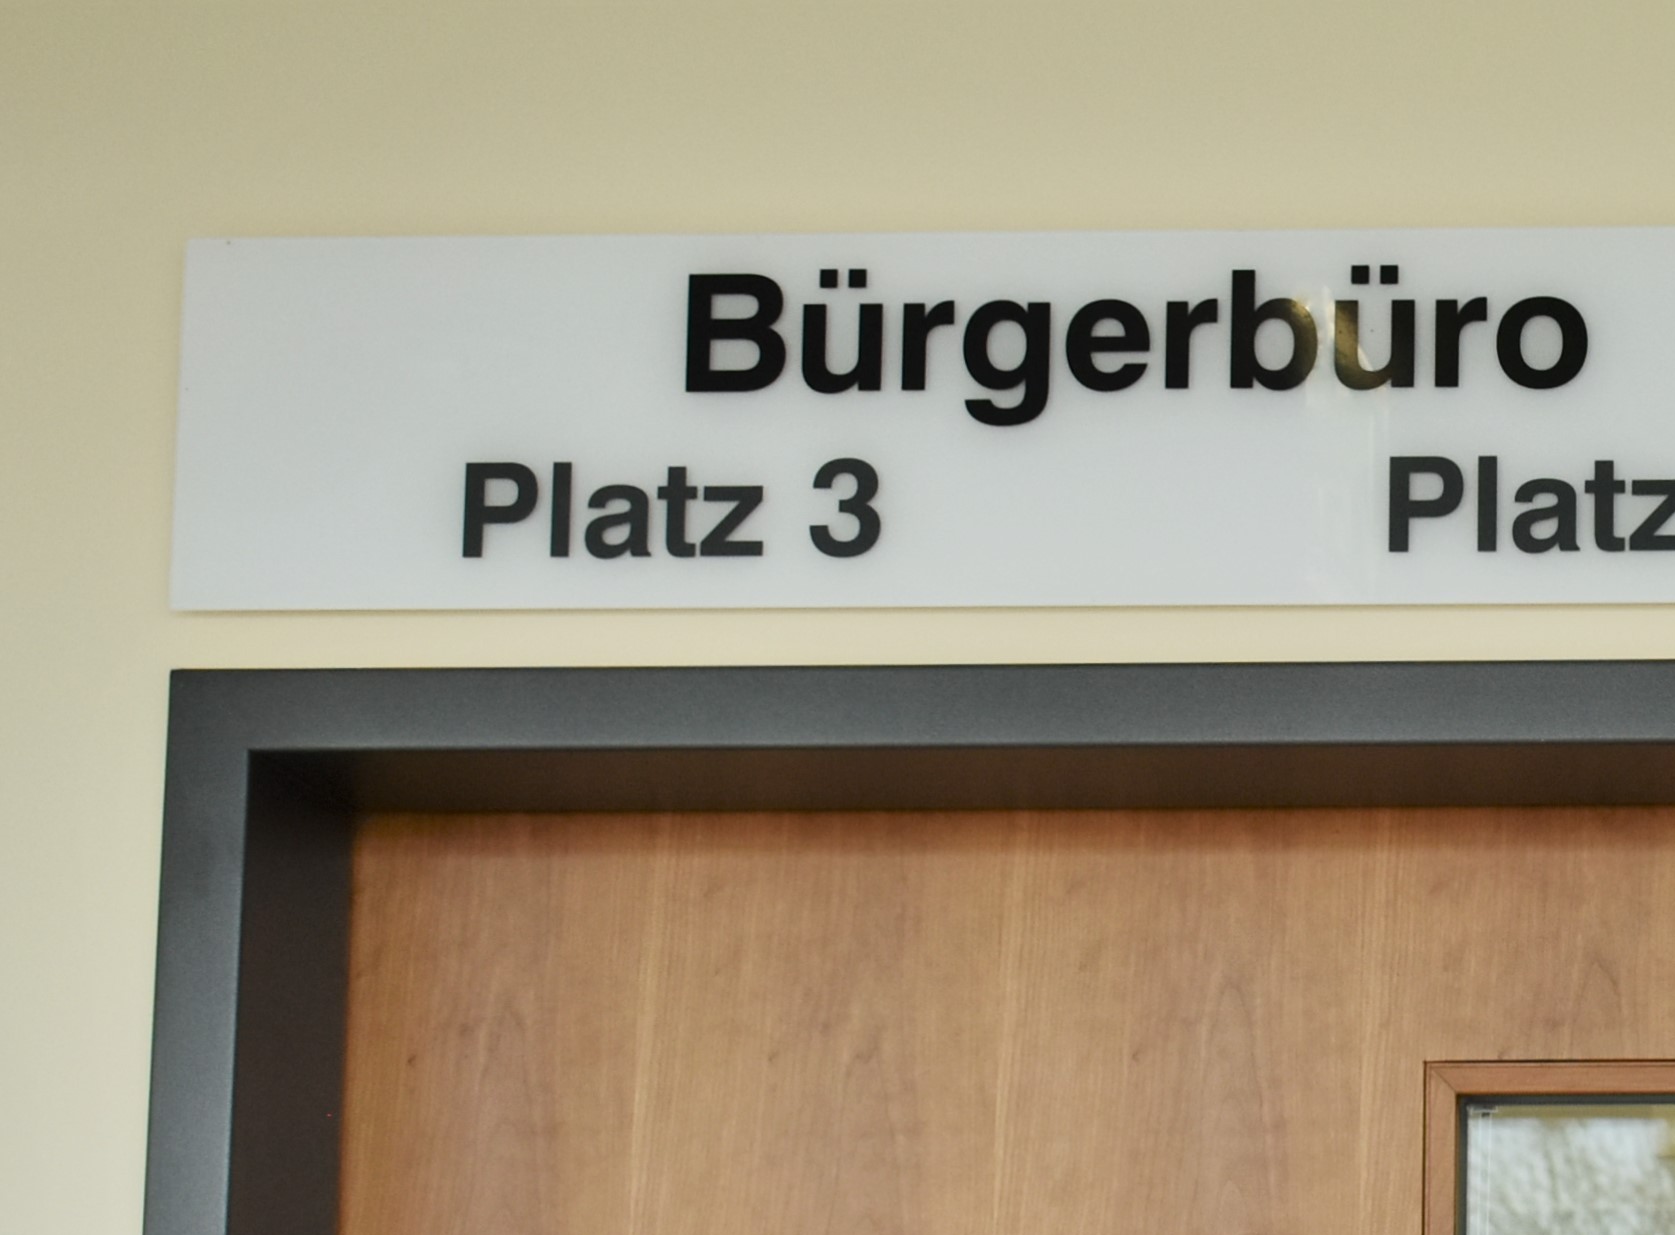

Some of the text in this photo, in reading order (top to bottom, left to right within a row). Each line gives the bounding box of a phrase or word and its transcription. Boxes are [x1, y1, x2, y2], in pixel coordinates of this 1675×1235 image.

[685, 265, 1588, 427] Bürgerbüro
[462, 458, 881, 560] Platz 3
